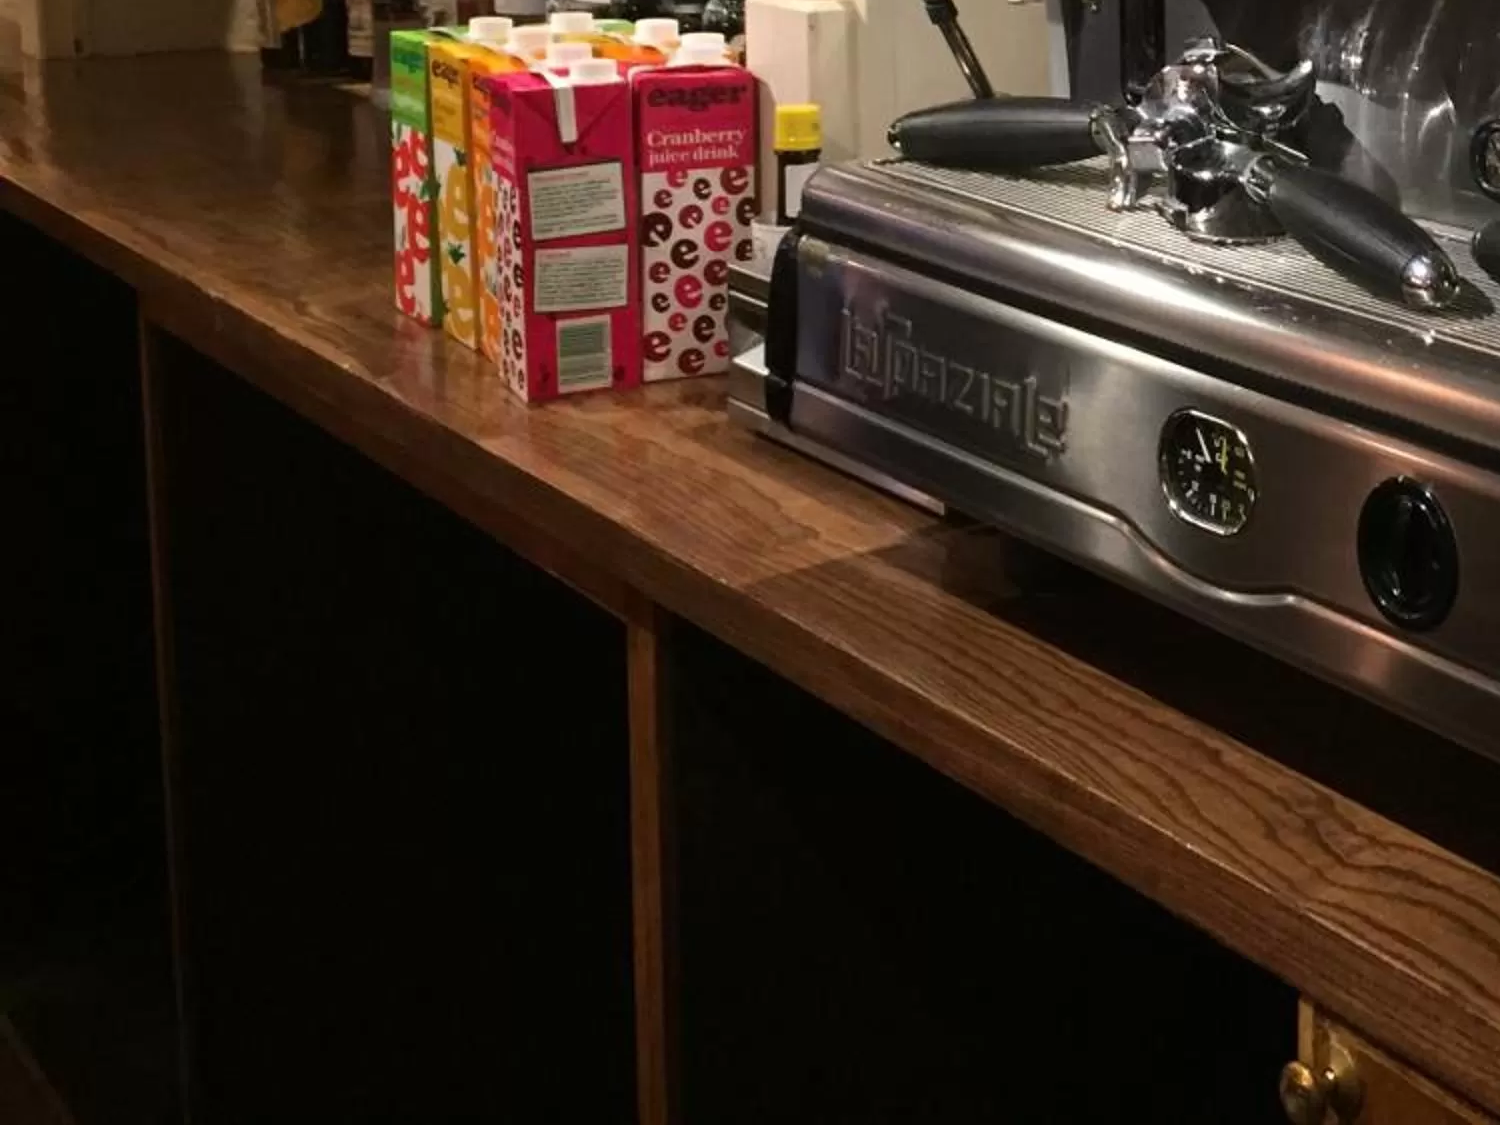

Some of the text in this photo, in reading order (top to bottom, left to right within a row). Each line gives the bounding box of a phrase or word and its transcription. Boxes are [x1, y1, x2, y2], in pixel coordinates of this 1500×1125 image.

[646, 84, 748, 112] eager
[646, 128, 744, 148] Cranberry
[648, 144, 739, 168] juice drink
